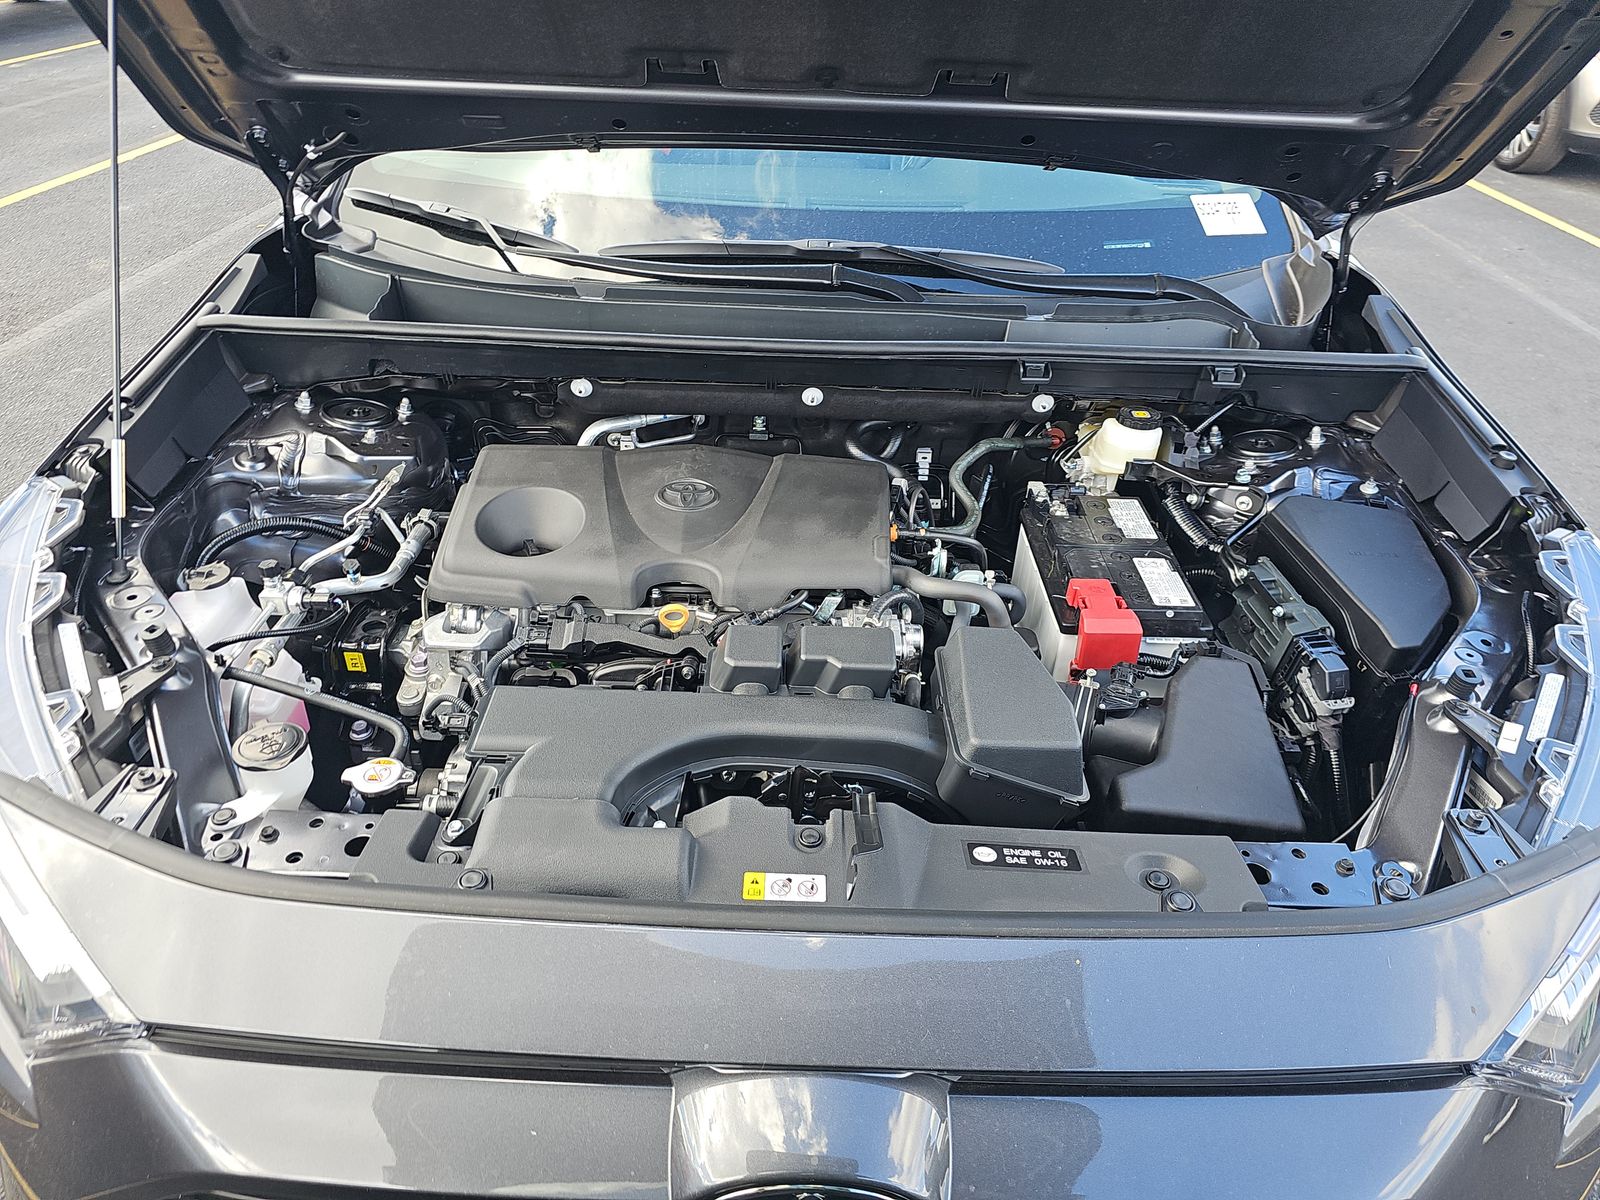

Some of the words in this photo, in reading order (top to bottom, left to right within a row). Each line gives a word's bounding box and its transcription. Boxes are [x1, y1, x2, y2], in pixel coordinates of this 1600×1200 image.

[1002, 847, 1042, 857] ENGINE
[1047, 851, 1066, 859] OIL
[1005, 856, 1028, 865] SAE
[1034, 858, 1068, 867] 0W-16
